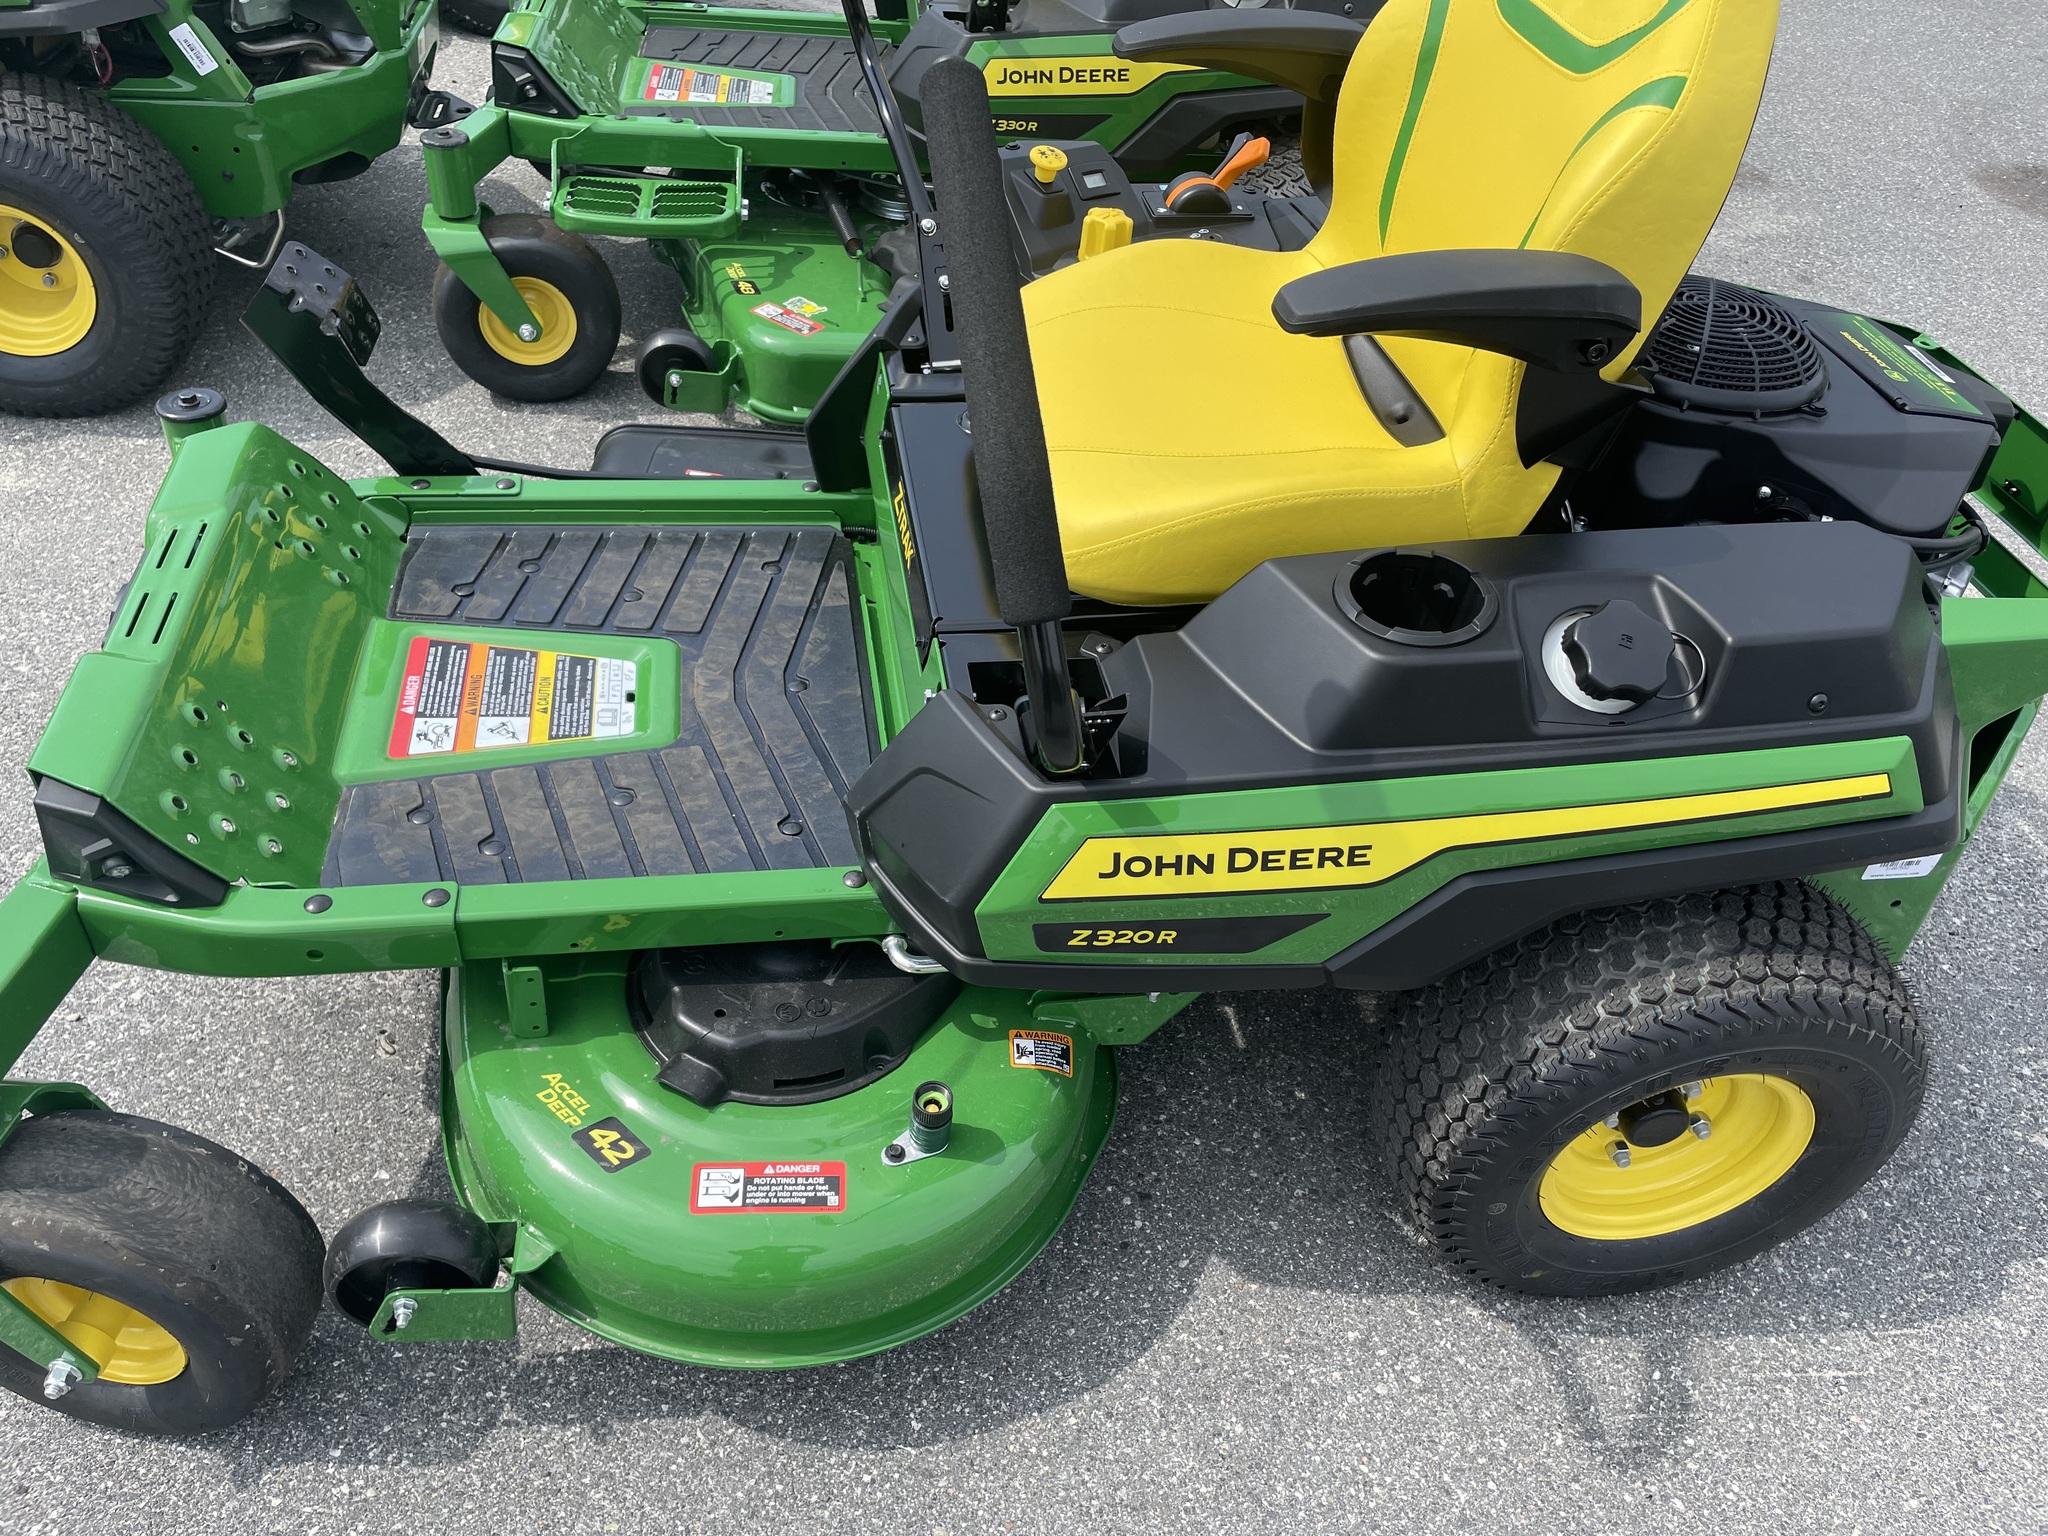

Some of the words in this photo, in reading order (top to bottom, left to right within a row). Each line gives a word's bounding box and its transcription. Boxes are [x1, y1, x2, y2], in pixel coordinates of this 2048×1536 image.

[996, 67, 1053, 85] JOHN
[1059, 66, 1130, 83] DEERE
[738, 281, 755, 294] 48
[407, 675, 421, 706] DANGER
[470, 674, 482, 707] WARNING
[537, 676, 551, 706] CAUTION
[1098, 851, 1215, 879] JOHN
[1227, 844, 1373, 874] DEERE
[1025, 1032, 1069, 1044] WARNING
[536, 1088, 582, 1127] DEEP
[541, 1073, 591, 1116] ACCEL
[588, 1129, 635, 1166] 42
[776, 1164, 820, 1174] DANGER
